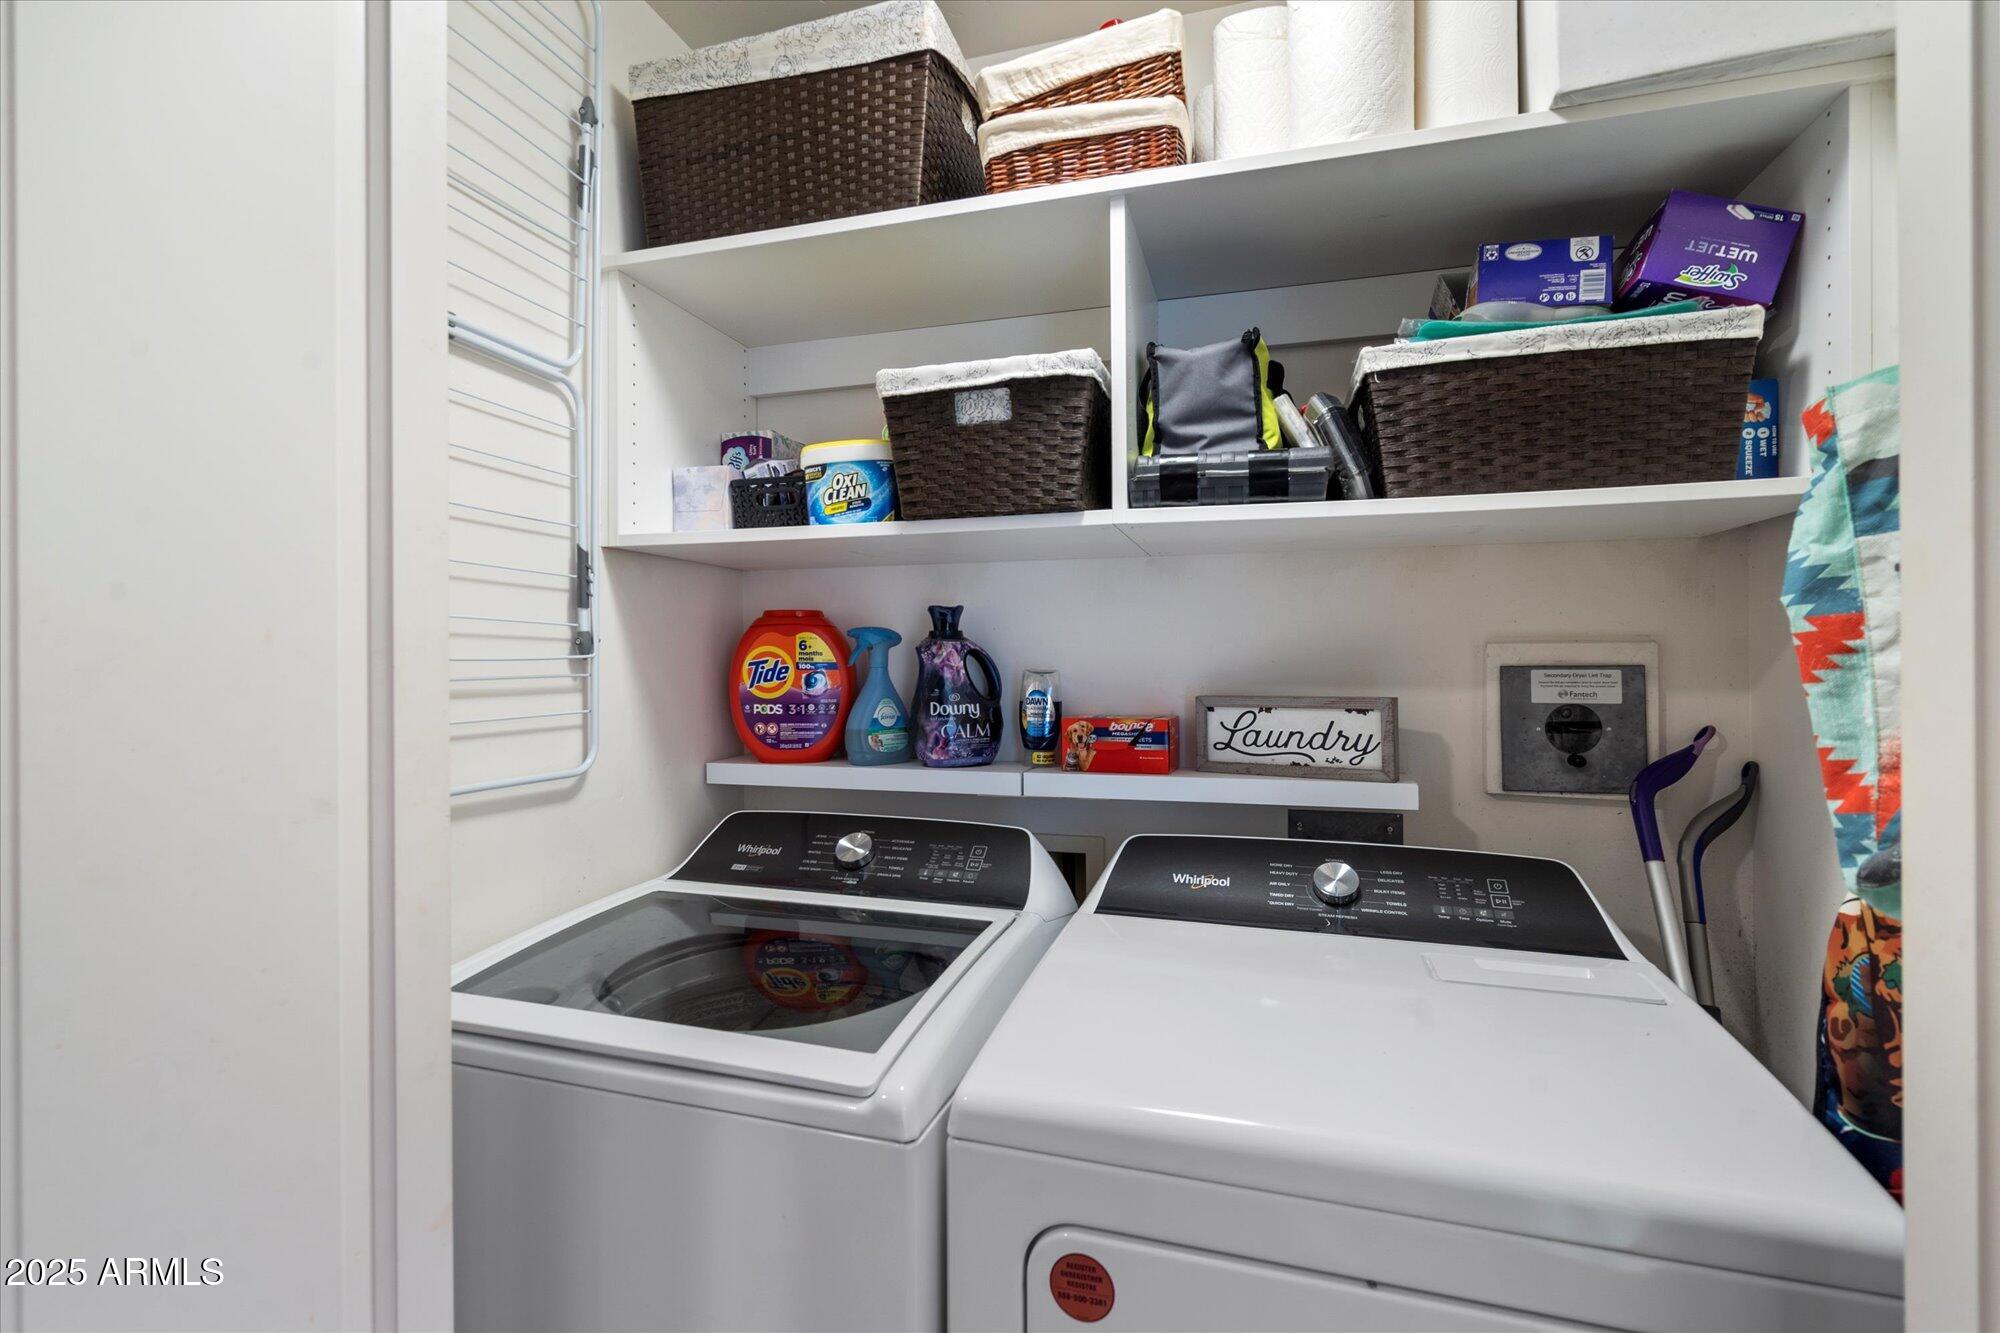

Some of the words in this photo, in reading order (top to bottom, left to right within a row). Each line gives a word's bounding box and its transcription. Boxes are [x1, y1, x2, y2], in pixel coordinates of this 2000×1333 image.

[1684, 240, 1759, 264] WETJET
[1679, 264, 1748, 290] Swiffer
[1745, 440, 1753, 476] SQUEEZE
[832, 472, 859, 489] OXI
[824, 483, 868, 506] CLEAN
[747, 656, 790, 690] Tide
[753, 704, 783, 714] PODS
[1026, 697, 1049, 706] DAWN
[930, 702, 980, 718] Downy
[941, 723, 991, 739] CALM
[1108, 721, 1154, 732] bounce
[1213, 710, 1381, 766] Laundry
[737, 843, 783, 856] Whirlpool
[1172, 873, 1230, 888] Whirlpool
